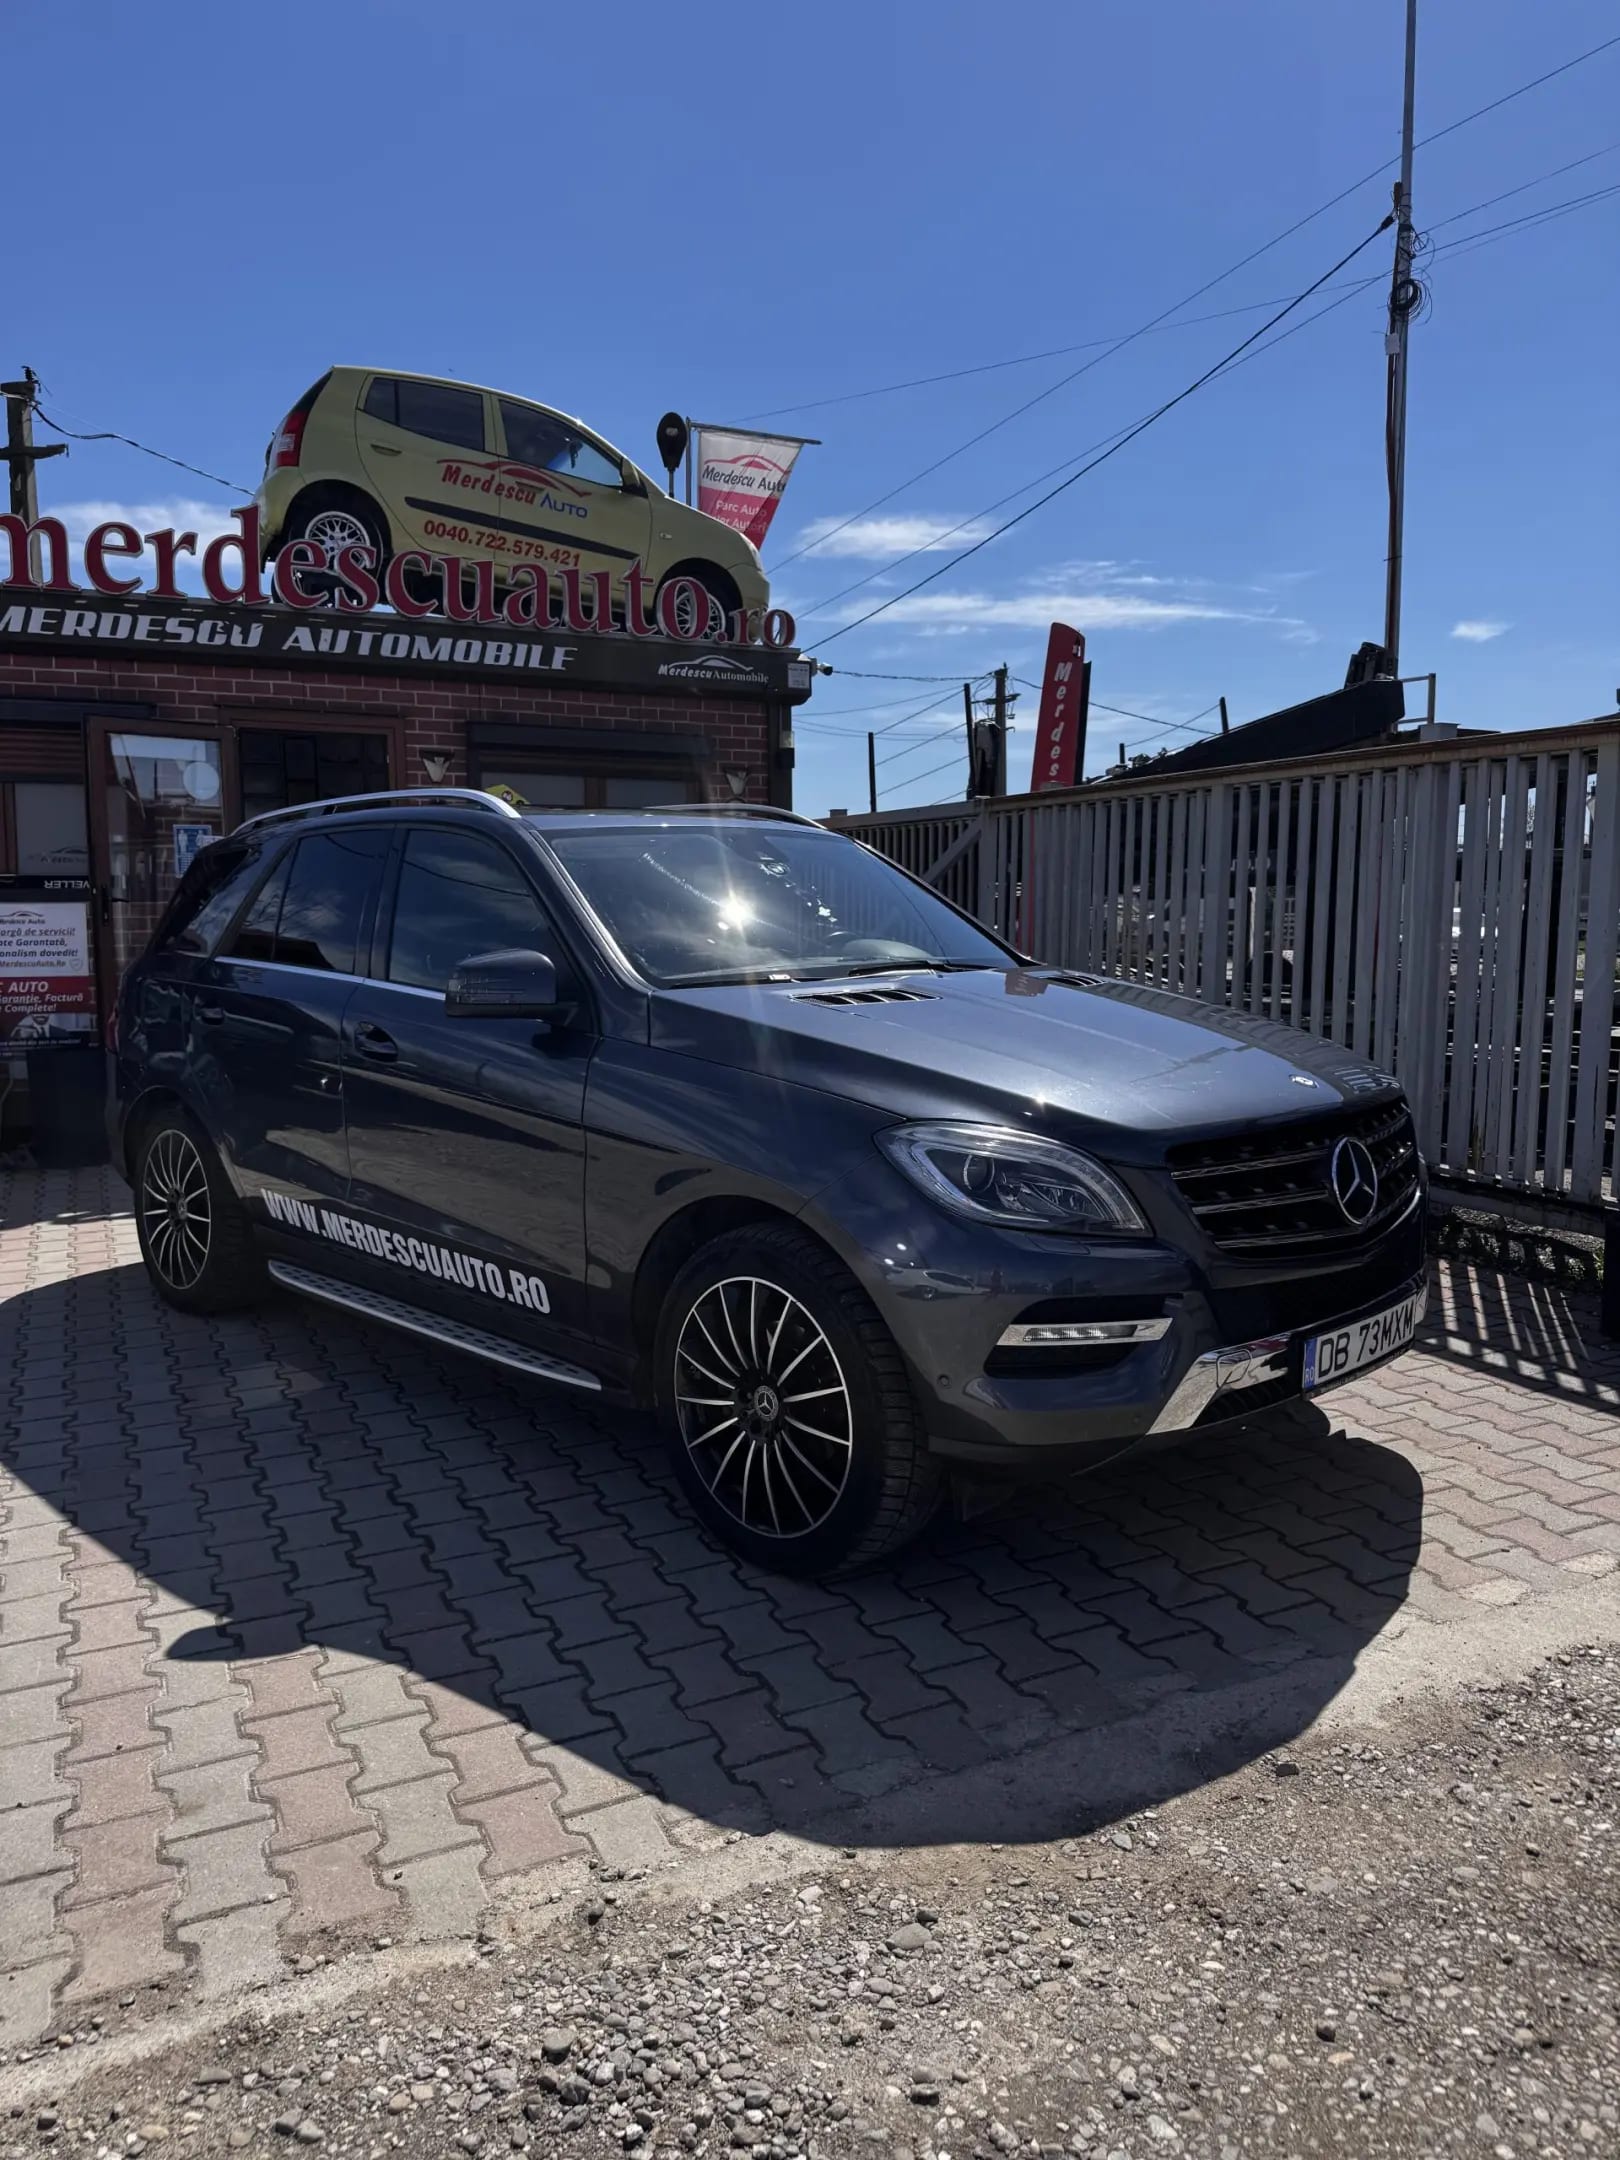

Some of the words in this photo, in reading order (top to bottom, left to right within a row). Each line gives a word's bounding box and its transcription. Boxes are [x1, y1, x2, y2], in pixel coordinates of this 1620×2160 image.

[702, 465, 756, 487] Merdescu
[442, 464, 537, 505] Merdescu
[540, 492, 588, 518] AUTO
[716, 500, 739, 513] Parc
[424, 520, 581, 567] 0040.722.579.421
[0, 503, 796, 649] merdescuauto.ro
[282, 625, 579, 672] AUTOMOBILE
[1049, 662, 1073, 777] Merdes
[16, 938, 68, 947] Garantată,
[25, 928, 37, 936] de
[39, 928, 76, 937] servicii!
[40, 948, 78, 957] dovedit!
[8, 981, 49, 993] AUTO
[45, 992, 84, 1002] Factură
[4, 1003, 57, 1014] Complete!
[260, 1188, 550, 1314] WWW.MERDESCUAUTO.RO
[1318, 1332, 1351, 1378] DB
